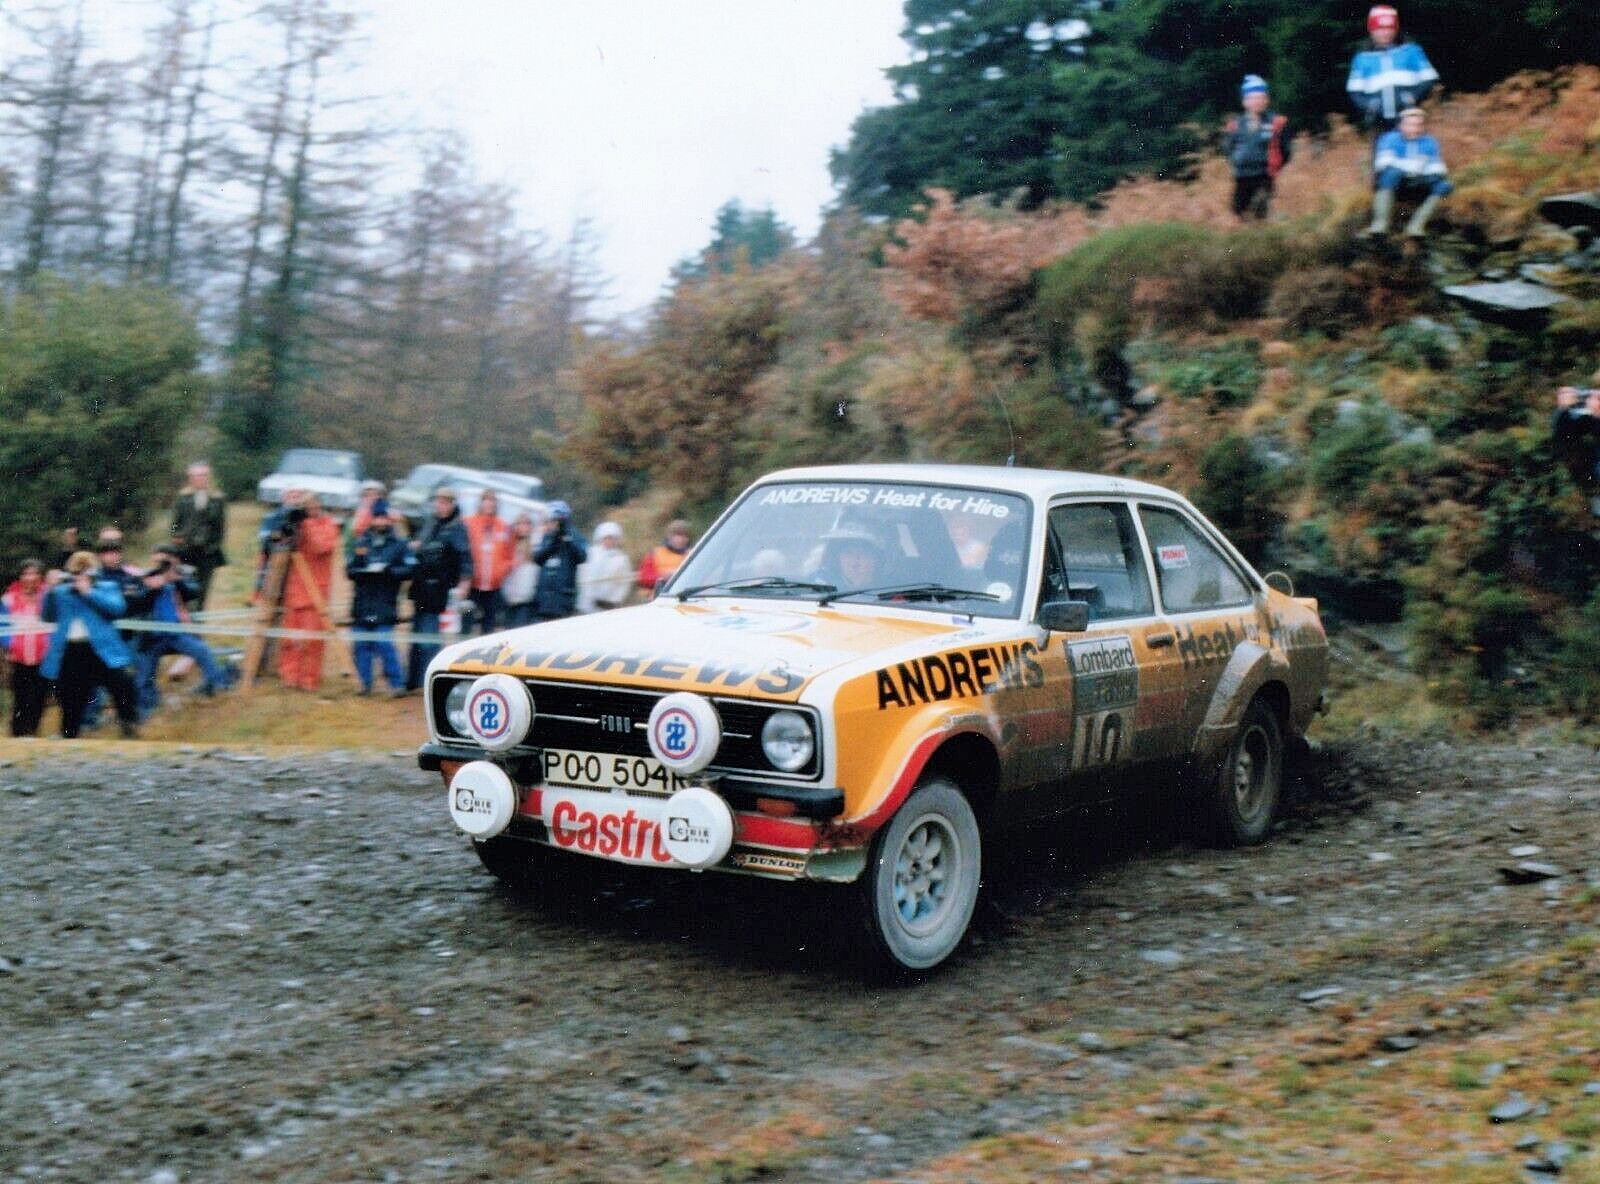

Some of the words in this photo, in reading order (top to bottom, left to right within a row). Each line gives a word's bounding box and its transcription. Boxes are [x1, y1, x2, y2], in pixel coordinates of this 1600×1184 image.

[760, 488, 870, 505] ANDREWS
[872, 489, 923, 508] Heat
[928, 491, 961, 511] for
[962, 496, 1010, 518] Hire
[452, 645, 805, 694] ANDREWS
[876, 641, 1045, 710] ANDREWS
[600, 714, 631, 733] FORD
[551, 800, 674, 863] Castro
[749, 855, 804, 869] DUNLOP
